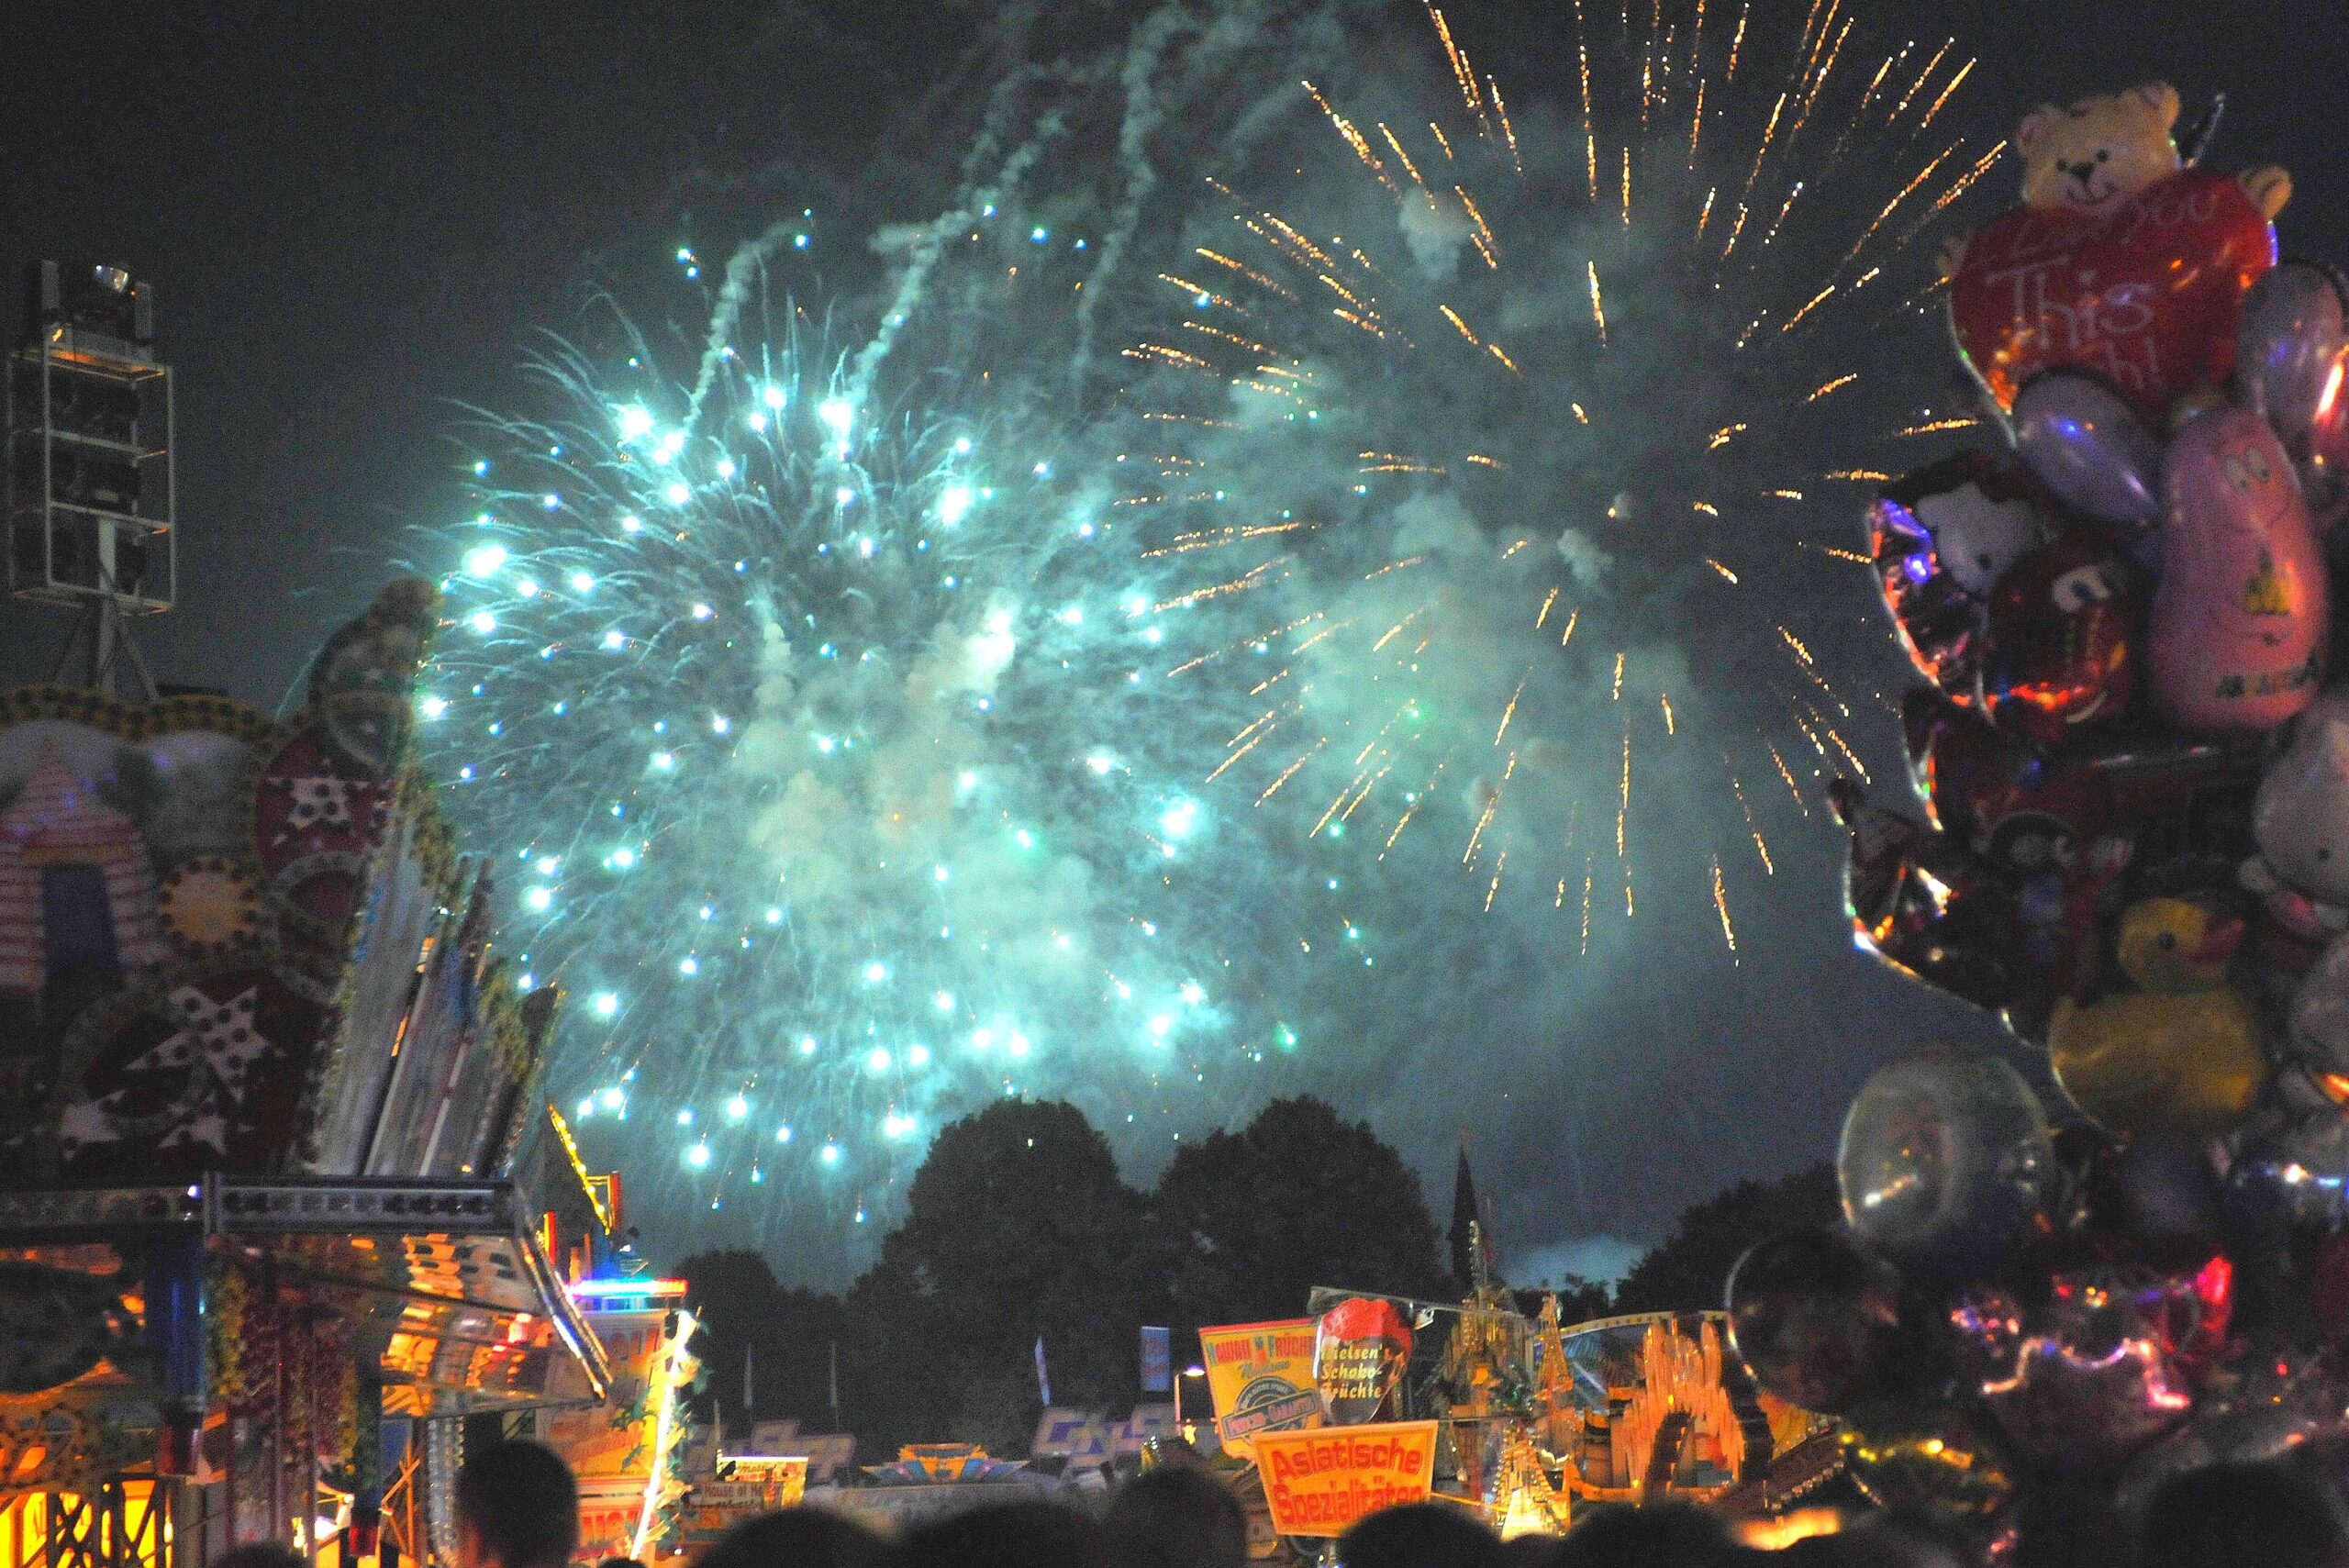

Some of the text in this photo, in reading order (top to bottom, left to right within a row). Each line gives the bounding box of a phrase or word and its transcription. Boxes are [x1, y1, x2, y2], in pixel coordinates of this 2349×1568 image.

[1984, 253, 2155, 350] This
[1321, 1380, 1382, 1398] Früchte
[1272, 1436, 1422, 1484] Asiatische
[1273, 1475, 1422, 1525] Spezialitäten
